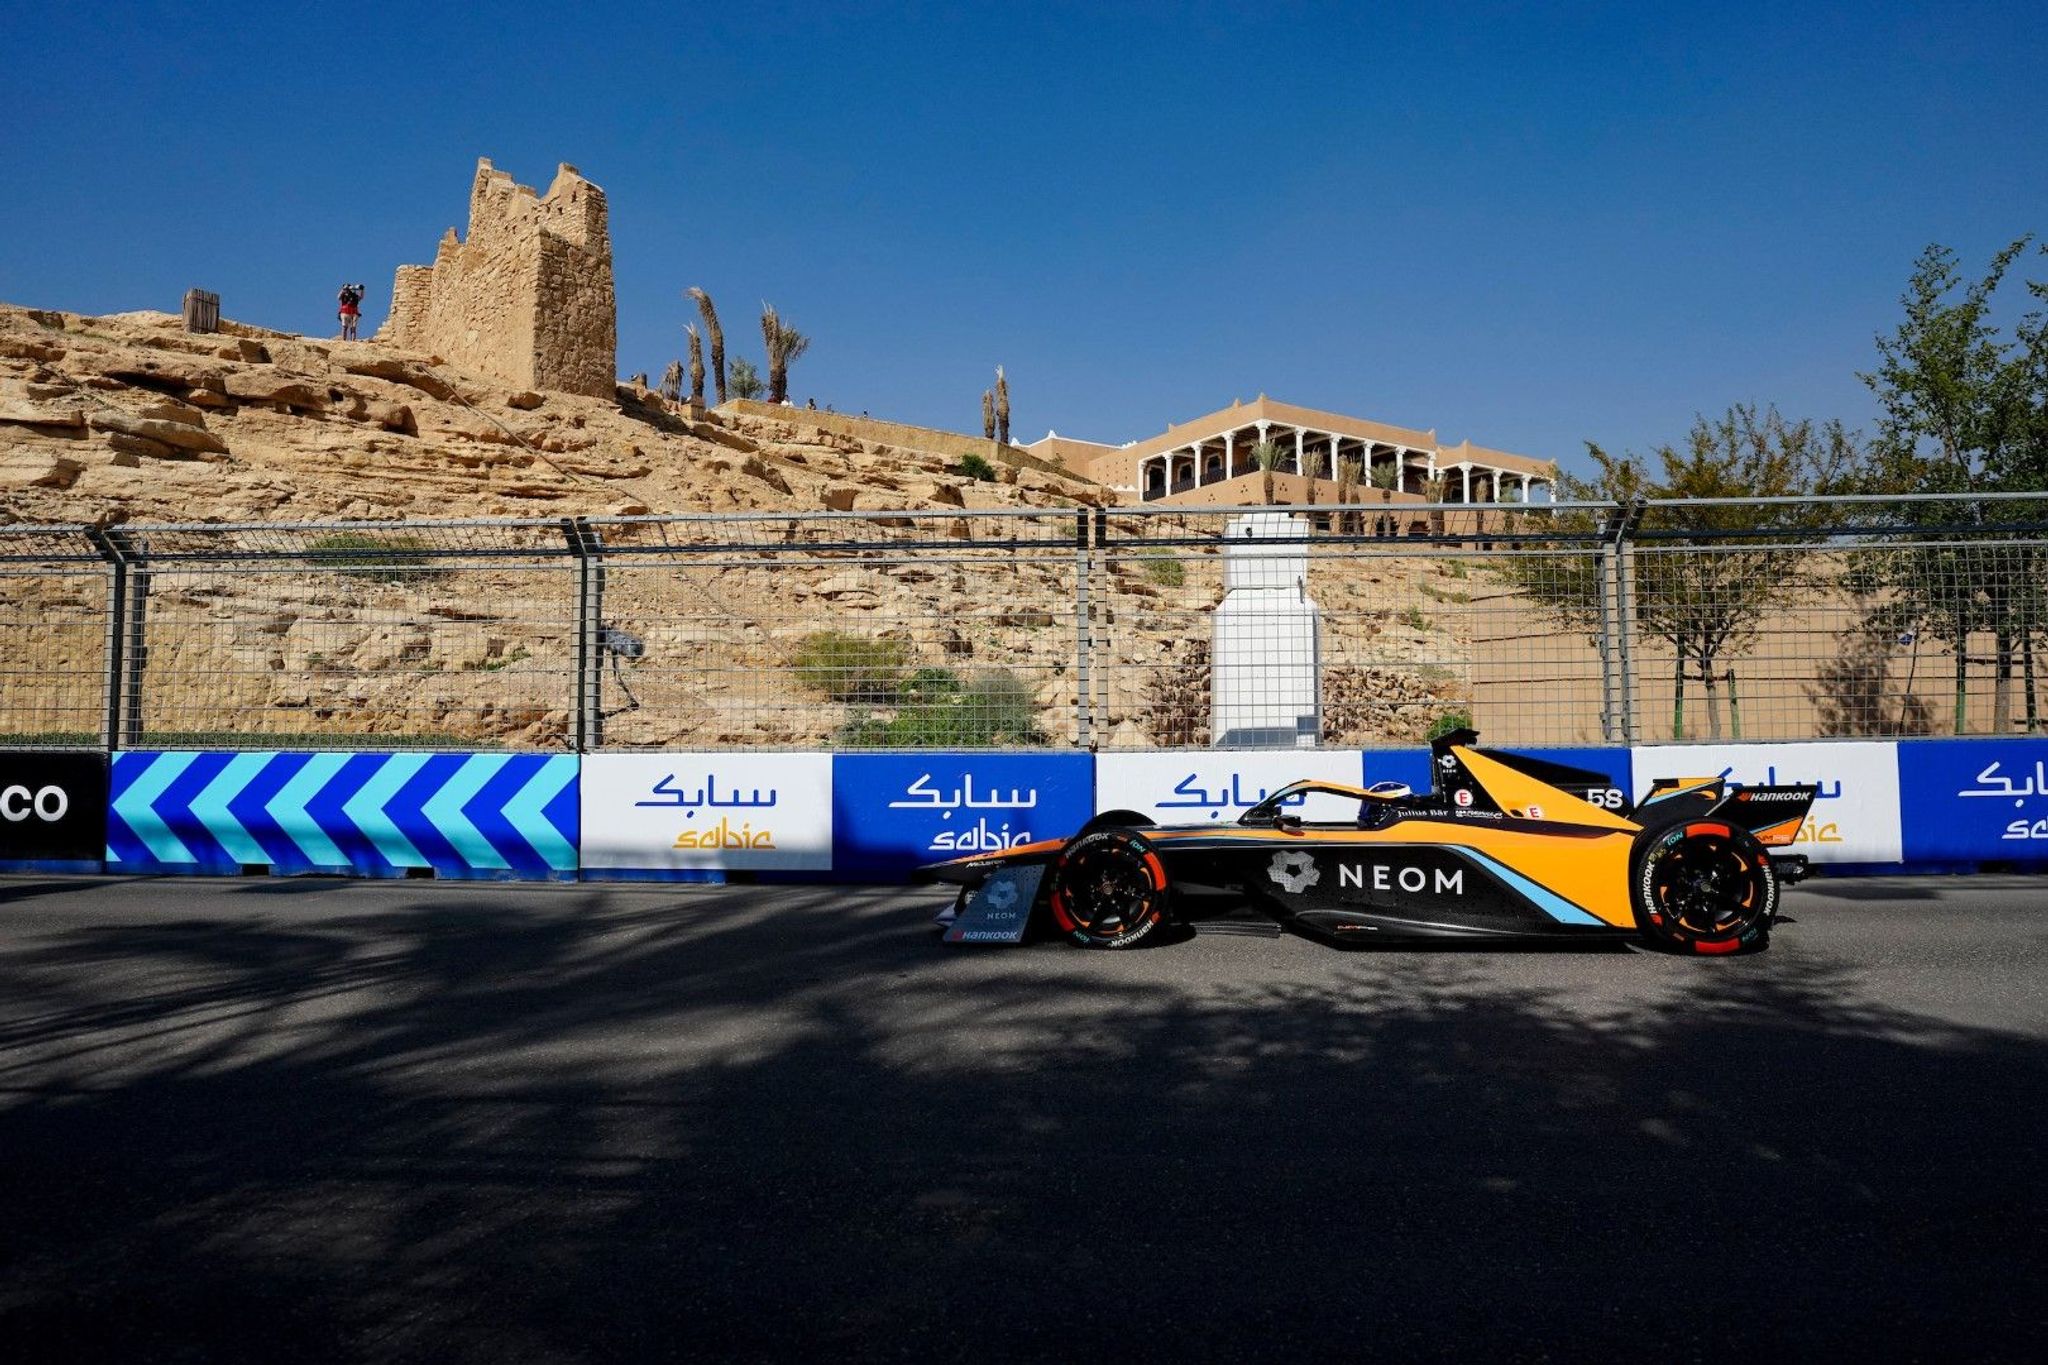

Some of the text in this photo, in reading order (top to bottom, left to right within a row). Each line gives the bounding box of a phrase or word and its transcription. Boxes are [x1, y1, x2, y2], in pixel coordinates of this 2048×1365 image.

[635, 773, 777, 819] سابك
[888, 773, 1037, 820] سابك
[1587, 788, 1624, 809] 58
[1397, 809, 1428, 818] Julius
[671, 816, 777, 849] sabic
[1339, 863, 1463, 895] NEOM
